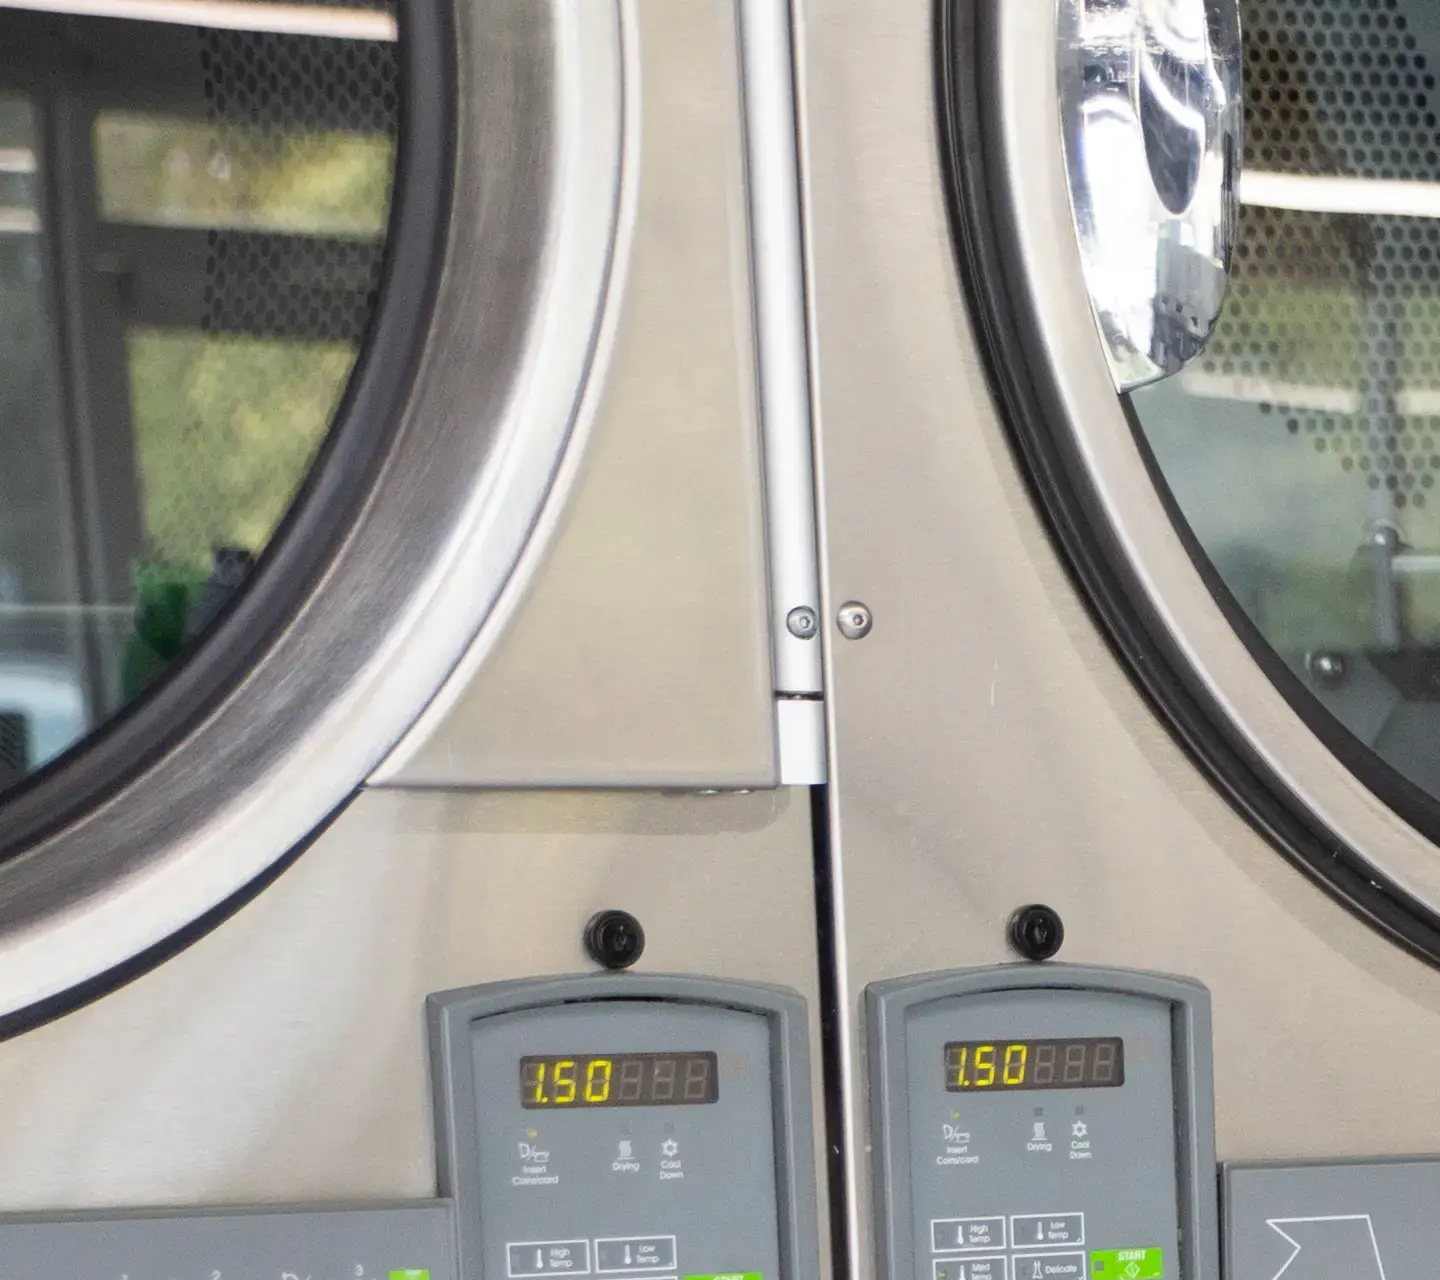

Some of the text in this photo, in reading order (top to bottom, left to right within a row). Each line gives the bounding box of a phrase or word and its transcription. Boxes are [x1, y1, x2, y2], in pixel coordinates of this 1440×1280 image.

[536, 1060, 612, 1103] 1.50
[958, 1045, 1028, 1086] 1.50
[1118, 1250, 1146, 1261] START
